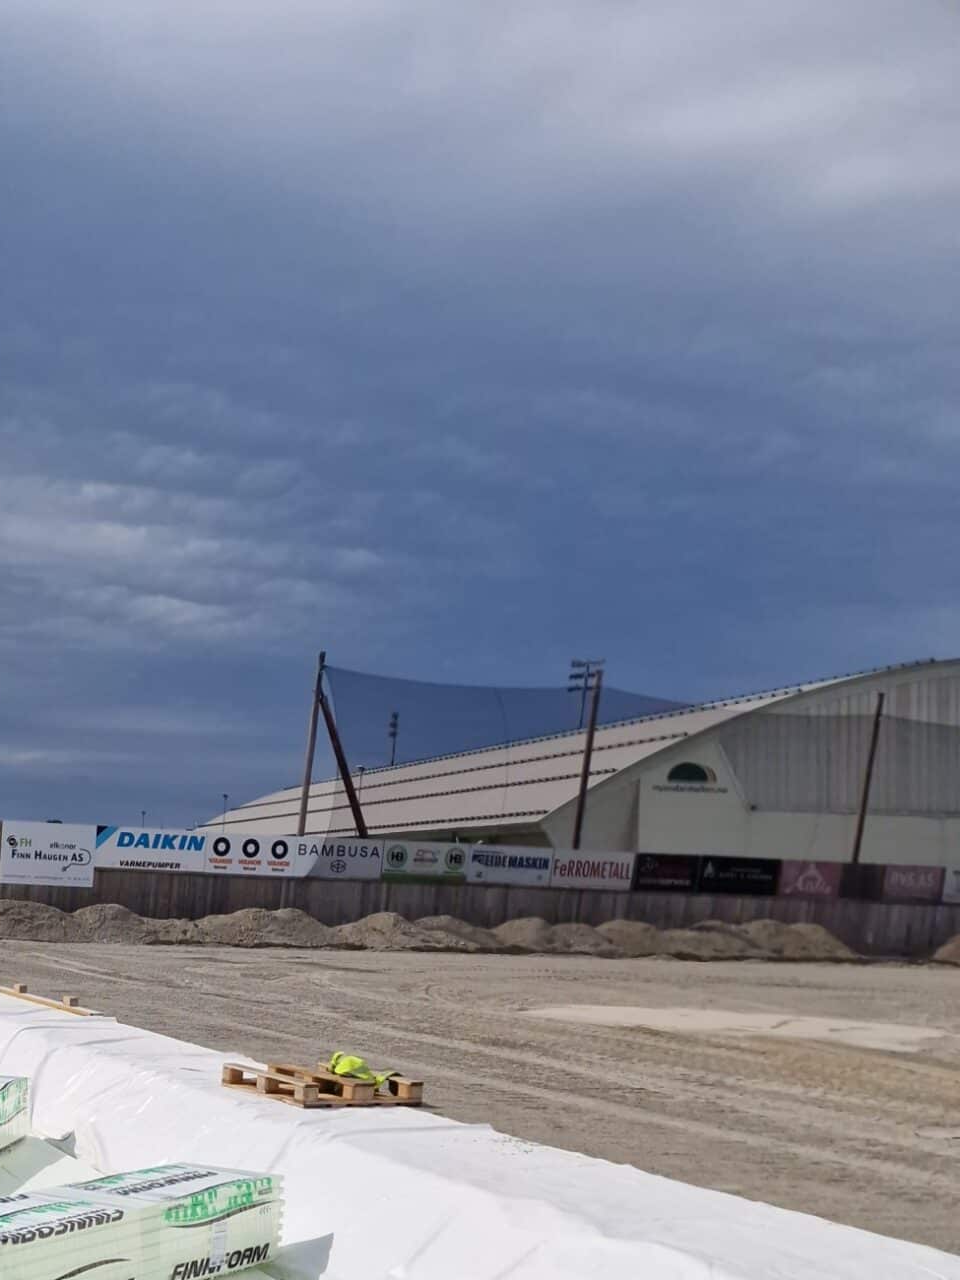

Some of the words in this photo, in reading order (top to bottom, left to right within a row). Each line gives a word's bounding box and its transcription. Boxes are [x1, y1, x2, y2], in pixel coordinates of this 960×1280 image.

[20, 838, 32, 847] FH
[117, 831, 206, 851] DAIKIN
[298, 843, 381, 858] BAMBUSA
[71, 853, 84, 862] AS
[120, 860, 181, 869] VARMEPUMPER
[508, 857, 550, 870] MASKIN
